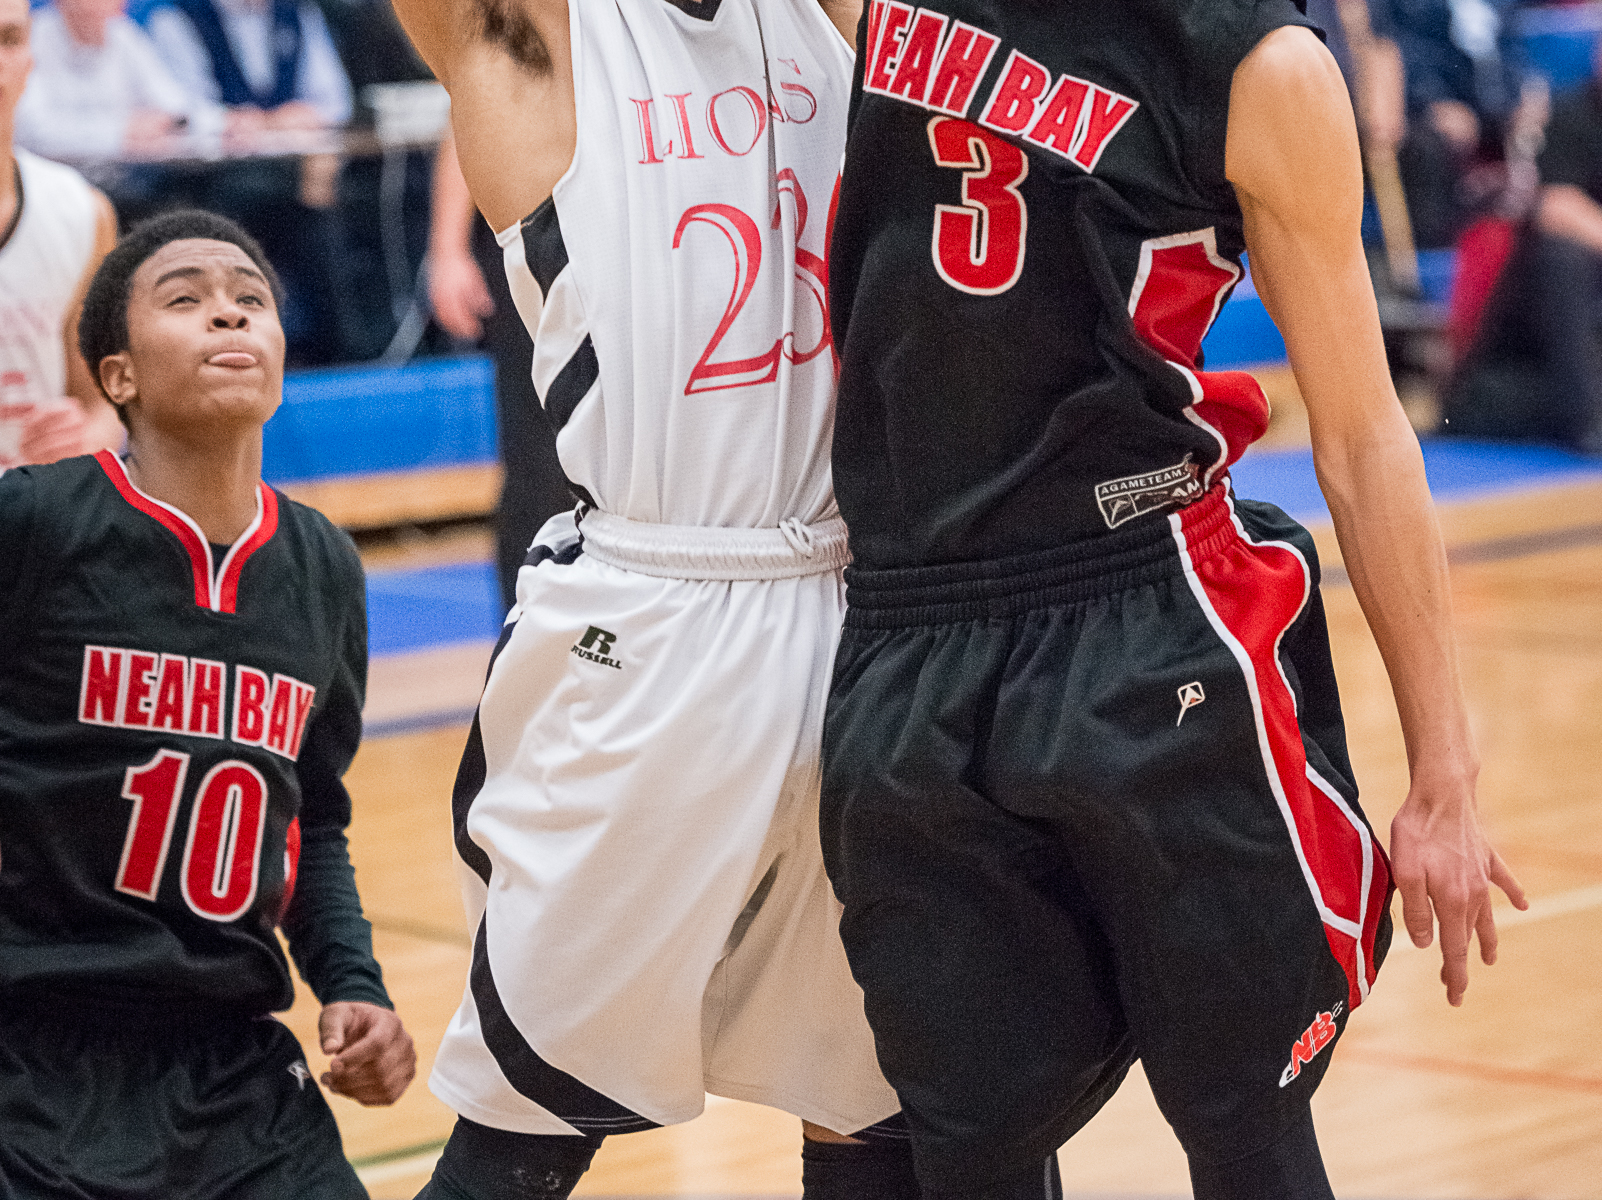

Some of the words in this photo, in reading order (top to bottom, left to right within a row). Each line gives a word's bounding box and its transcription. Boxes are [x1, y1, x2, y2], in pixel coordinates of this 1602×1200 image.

[978, 49, 1140, 175] BAY
[927, 115, 1029, 296] 3
[571, 644, 622, 670] RUSSELL
[579, 625, 617, 656] R
[79, 645, 227, 740] NEAH
[231, 664, 316, 763] BAY
[114, 748, 269, 923] 10
